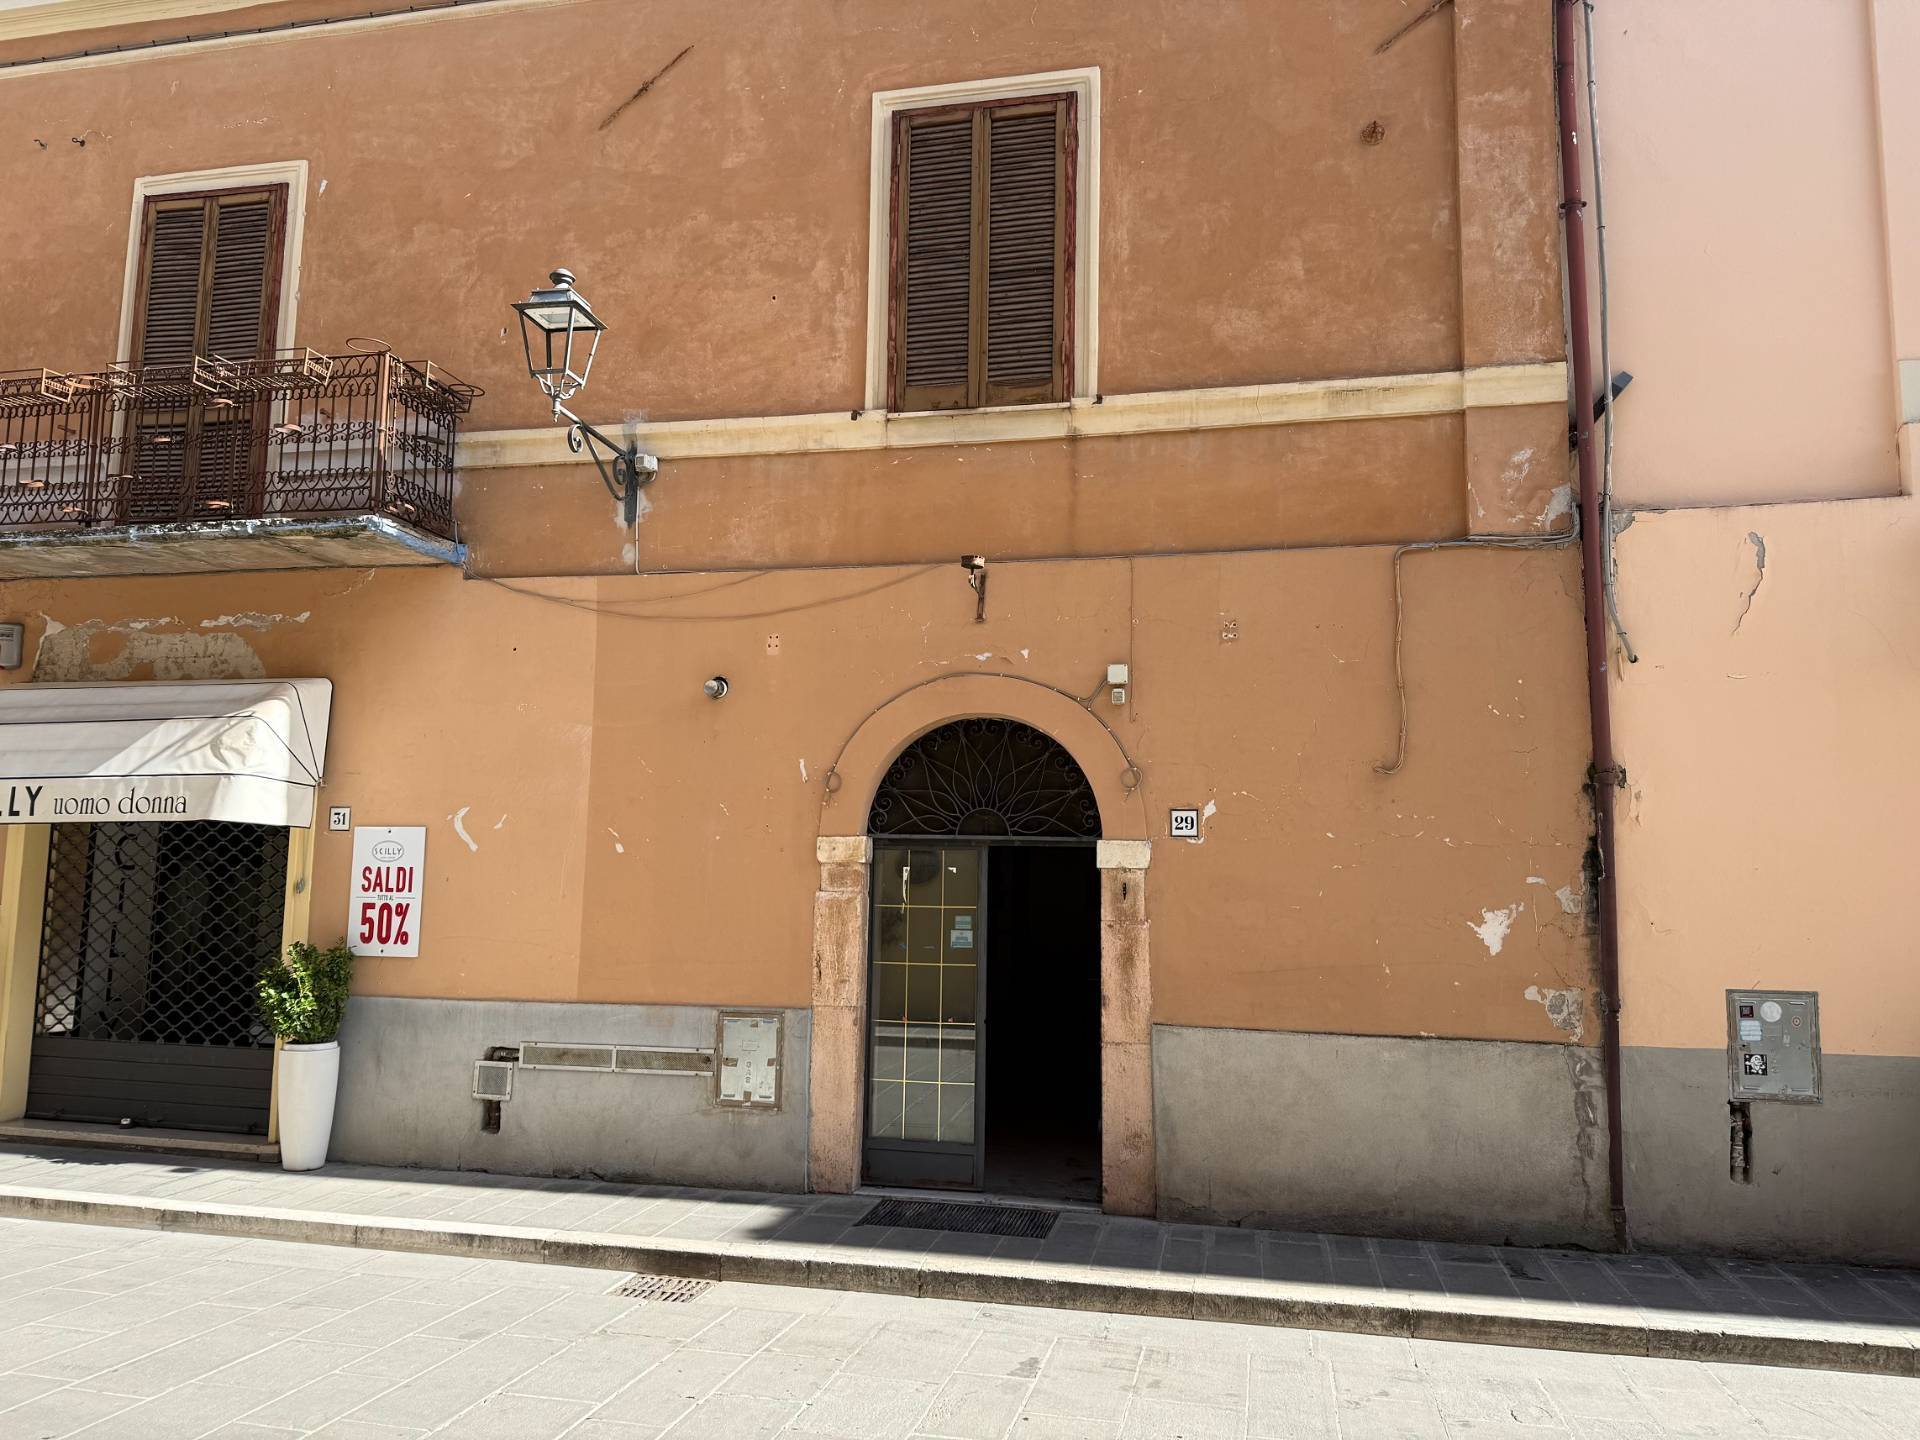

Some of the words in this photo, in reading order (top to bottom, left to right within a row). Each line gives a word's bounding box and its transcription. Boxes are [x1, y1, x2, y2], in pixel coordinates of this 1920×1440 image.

[0, 785, 43, 817] LY
[54, 797, 110, 815] uomo
[118, 786, 187, 815] donna
[333, 812, 346, 826] 31
[1174, 815, 1195, 831] 29
[374, 847, 402, 855] SCILLY
[361, 866, 414, 893] SALDI
[359, 902, 410, 945] 50%
